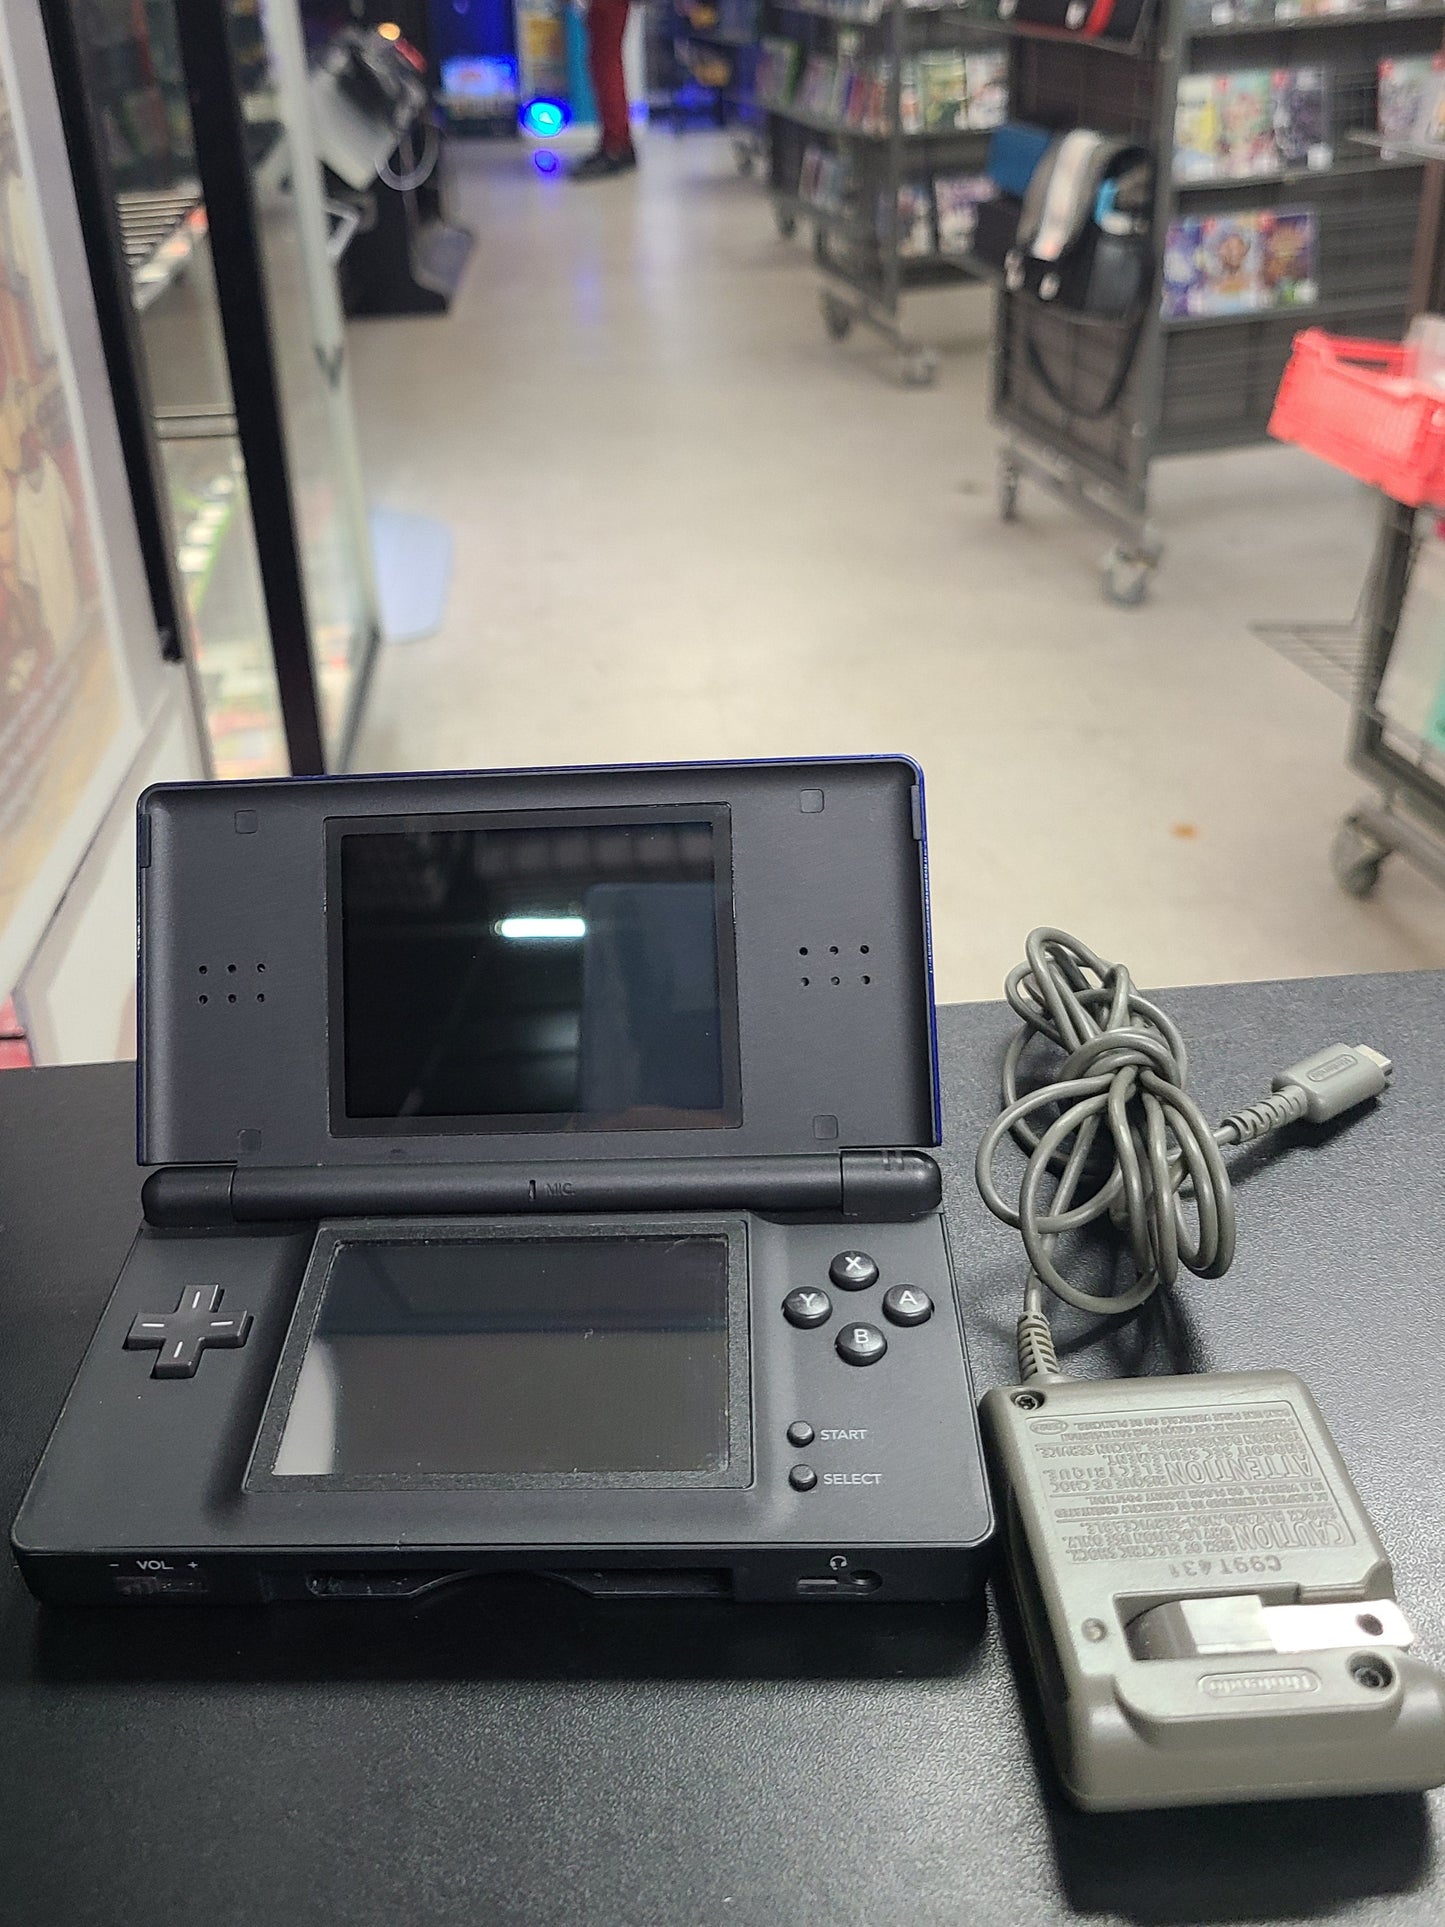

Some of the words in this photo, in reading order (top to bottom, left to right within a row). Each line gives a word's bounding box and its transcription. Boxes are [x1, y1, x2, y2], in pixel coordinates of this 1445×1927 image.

[844, 1256, 862, 1272] X
[799, 1292, 817, 1308] Y
[899, 1290, 918, 1305] A
[853, 1328, 869, 1344] B
[820, 1429, 868, 1441] START
[1165, 1455, 1313, 1484] ATTENTION
[822, 1473, 882, 1486] SELECT
[1231, 1522, 1344, 1549] CAUTION
[135, 1560, 174, 1570] VOL
